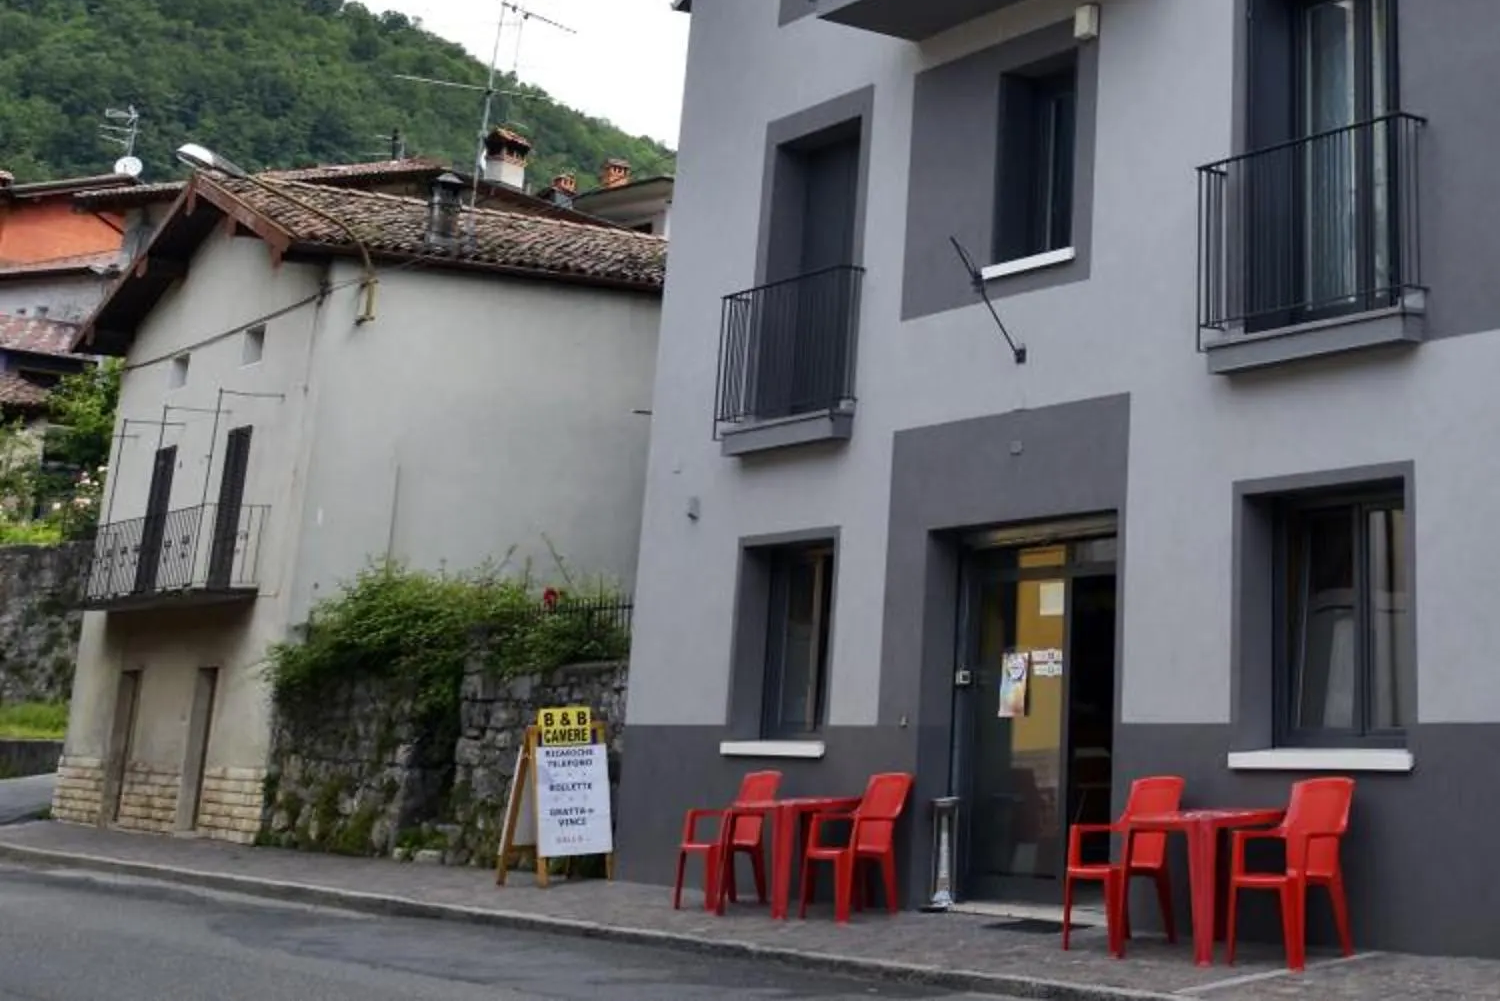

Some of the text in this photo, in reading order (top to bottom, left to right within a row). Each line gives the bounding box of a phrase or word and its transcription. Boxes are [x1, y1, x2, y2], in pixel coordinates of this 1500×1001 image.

[543, 711, 587, 727] B & B
[543, 728, 588, 744] CAMERE
